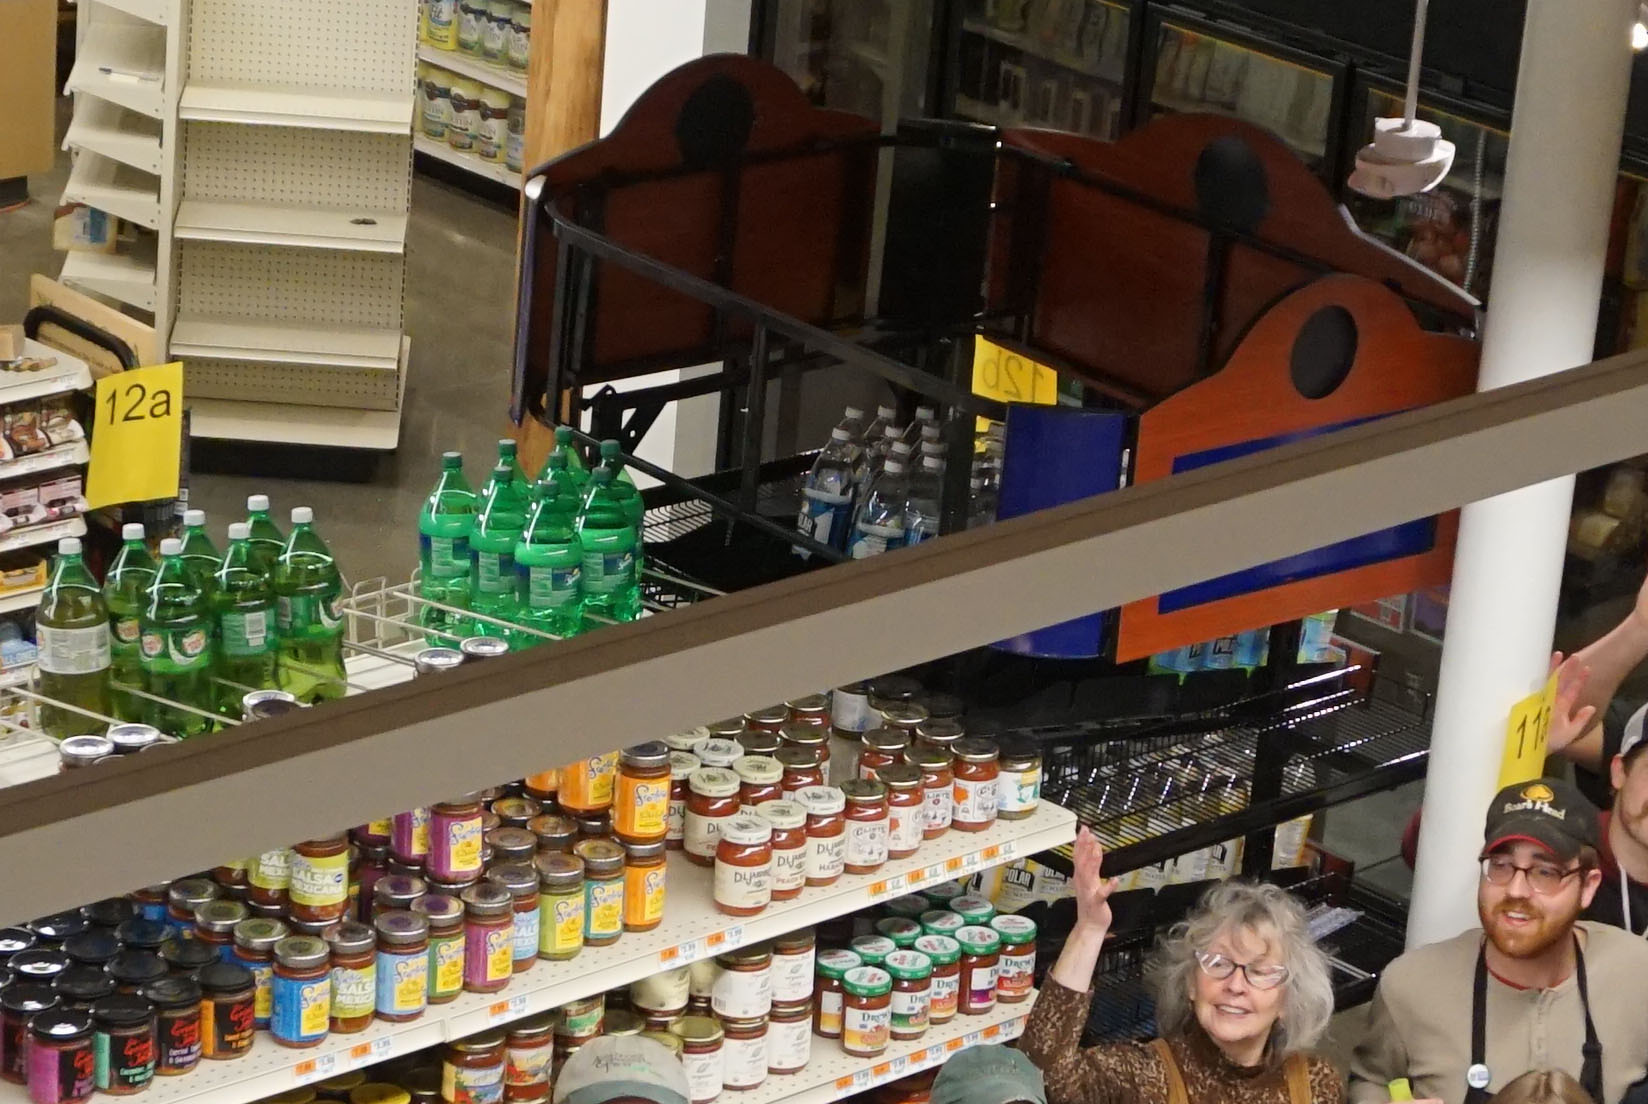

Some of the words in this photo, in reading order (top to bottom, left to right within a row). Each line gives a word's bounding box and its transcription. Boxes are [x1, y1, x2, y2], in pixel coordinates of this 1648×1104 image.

[106, 383, 172, 426] 12a
[291, 872, 335, 887] SALSA
[1008, 869, 1031, 887] OLAR
